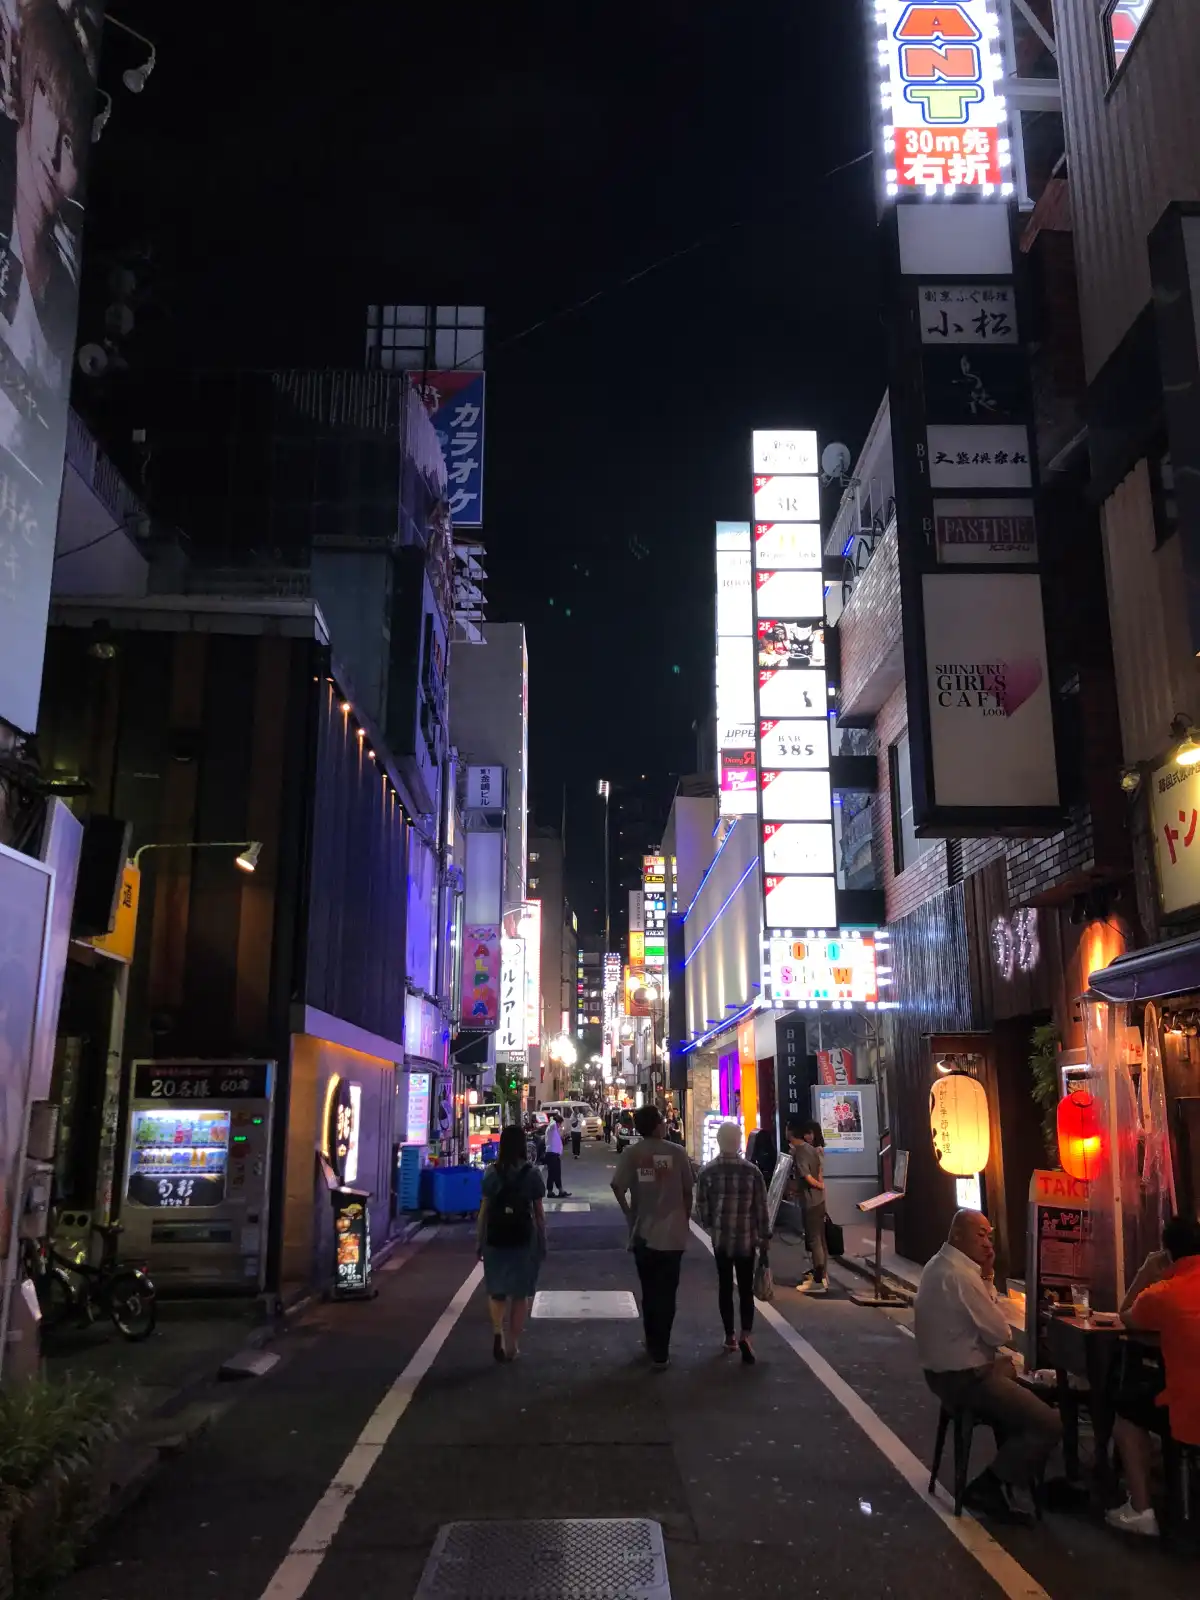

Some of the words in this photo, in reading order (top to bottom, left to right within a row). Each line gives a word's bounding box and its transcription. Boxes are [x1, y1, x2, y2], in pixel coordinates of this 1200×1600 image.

[893, 0, 984, 125] ANT
[905, 129, 990, 153] 30m先
[904, 154, 991, 185] 右折
[927, 309, 1012, 339] 小松
[448, 403, 482, 514] カラオケ
[757, 526, 768, 534] 3F
[937, 675, 1007, 691] GIRLS
[762, 721, 774, 731] 2F
[778, 744, 814, 756] 385
[763, 772, 775, 782] 2F
[765, 825, 776, 835] B1
[767, 877, 777, 887] B1
[472, 944, 490, 1017] ALPHA
[502, 968, 516, 1046] ルノアール
[786, 1029, 796, 1067] BAR
